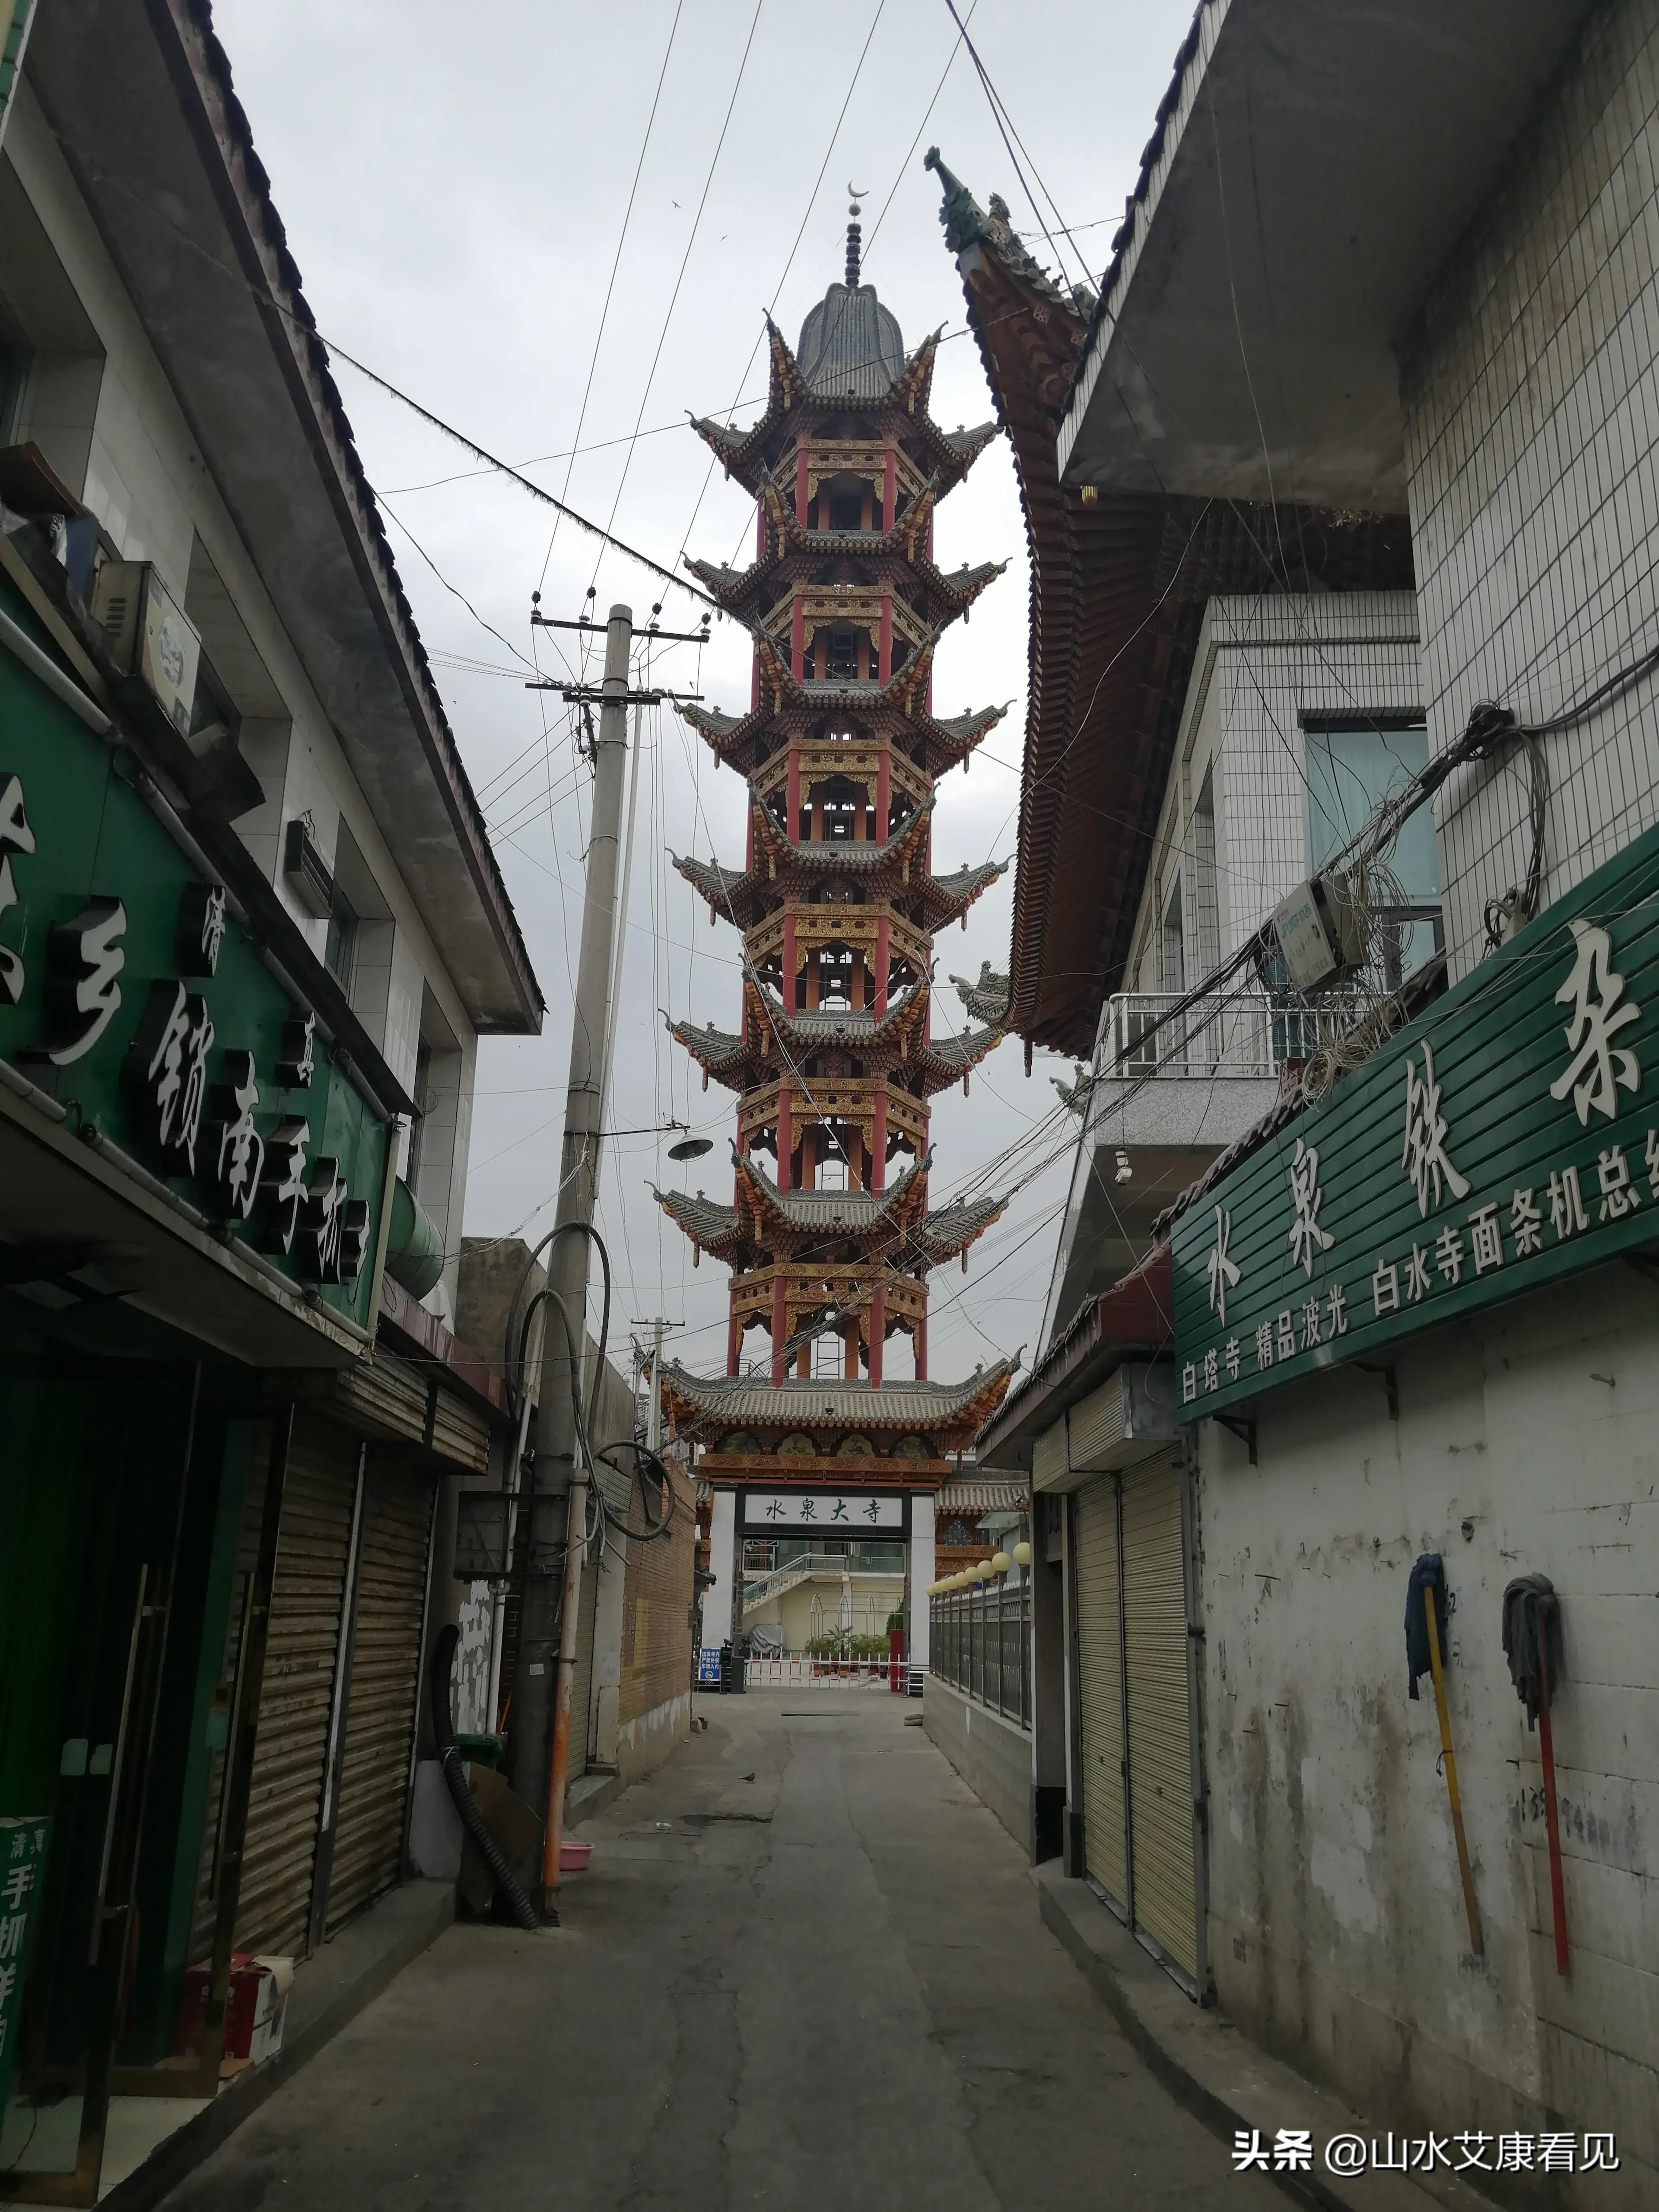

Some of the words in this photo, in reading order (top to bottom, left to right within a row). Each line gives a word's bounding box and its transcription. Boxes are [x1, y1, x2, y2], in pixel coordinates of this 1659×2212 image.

[1183, 1337, 1241, 1404] 白塔寺
[766, 1497, 881, 1523] 水泉大寺
[10, 1828, 45, 1859] 清真
